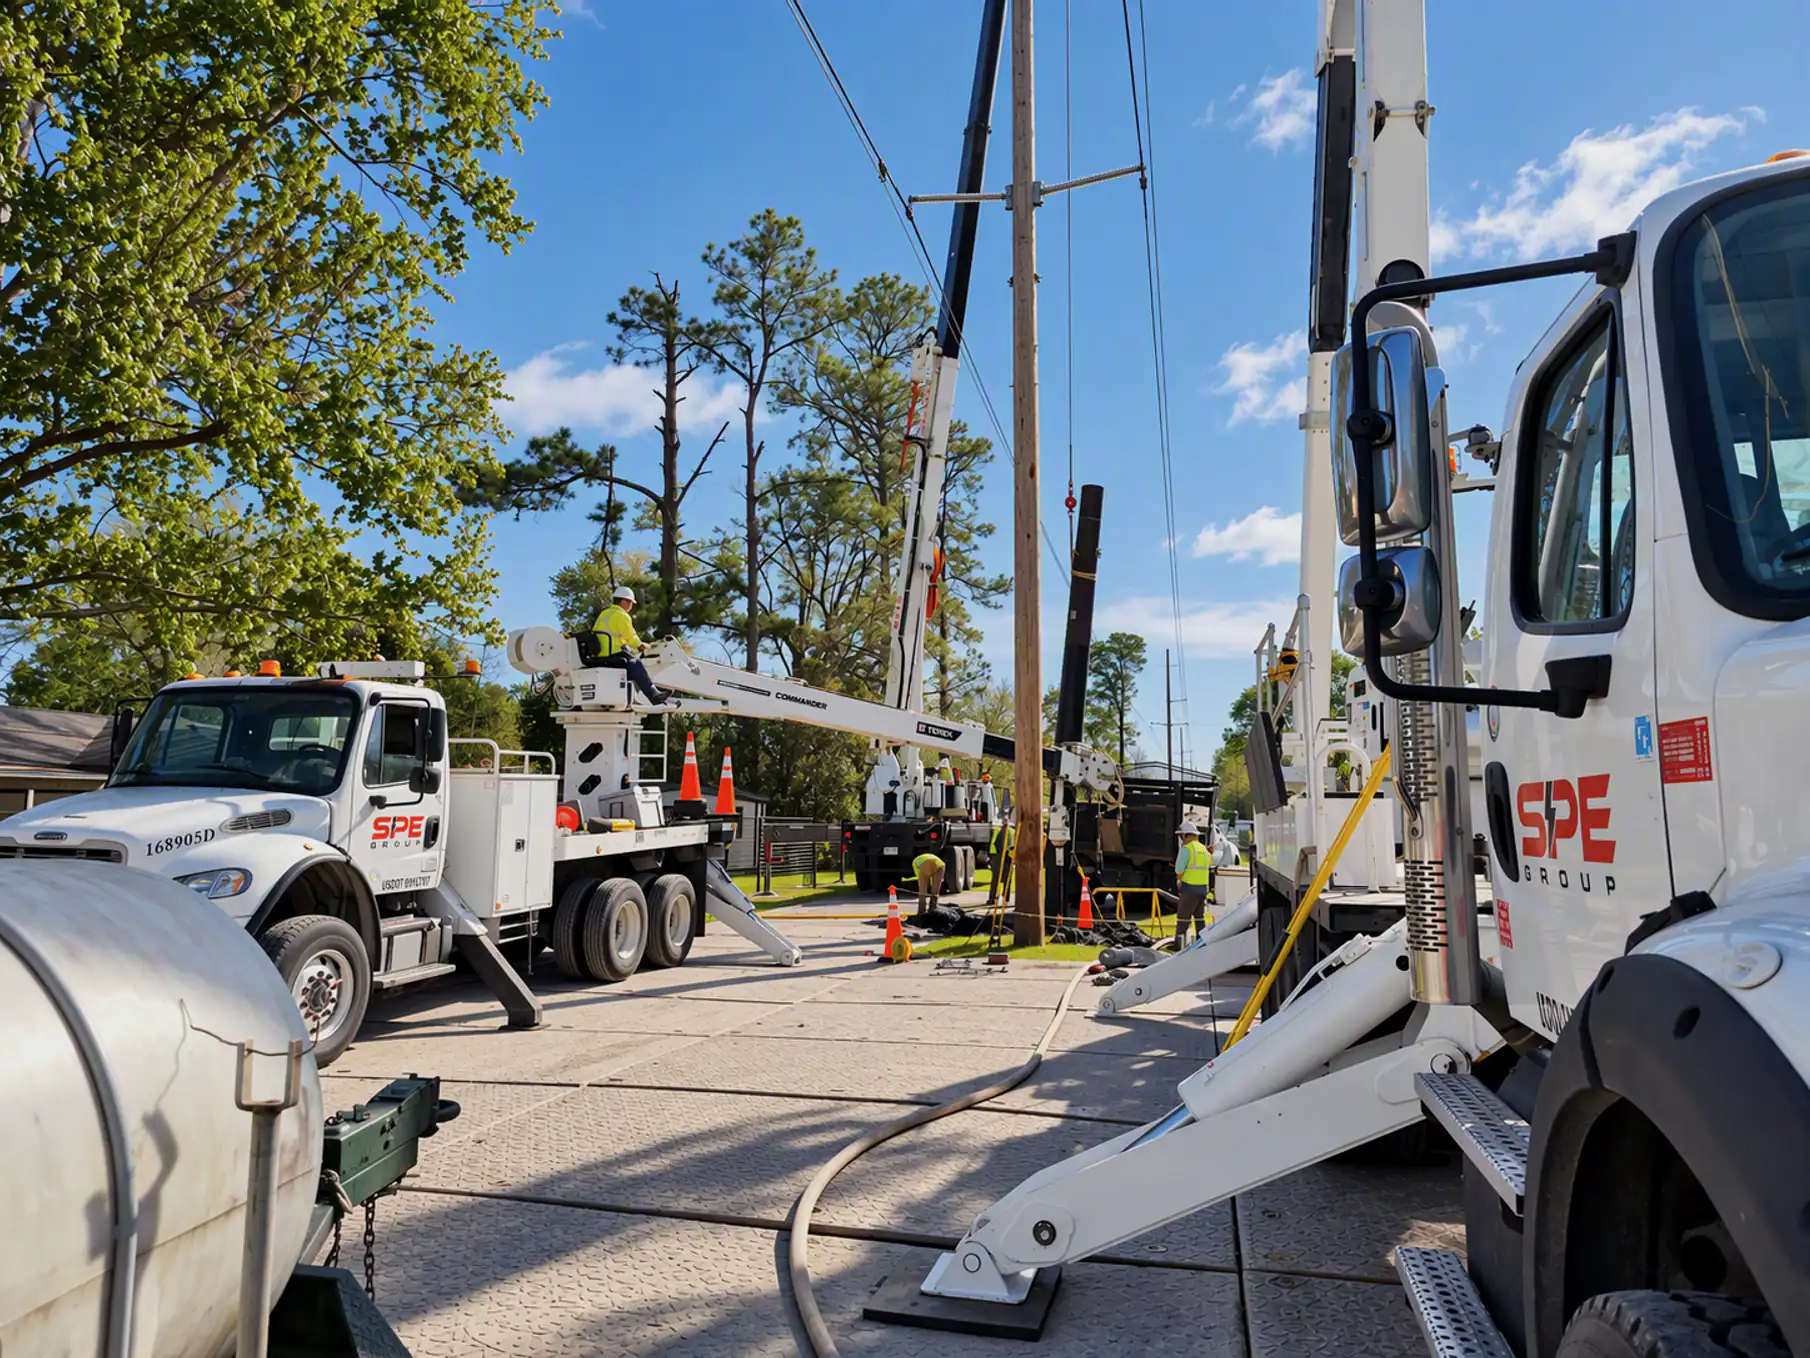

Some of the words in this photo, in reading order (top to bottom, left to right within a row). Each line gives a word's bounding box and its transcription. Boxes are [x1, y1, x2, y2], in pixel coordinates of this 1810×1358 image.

[775, 691, 828, 710] COMMANDER
[371, 815, 425, 840] SPE
[1517, 773, 1616, 864] SPE
[146, 828, 215, 857] 168905D
[370, 840, 421, 849] GROUP
[1524, 864, 1616, 896] GROUP
